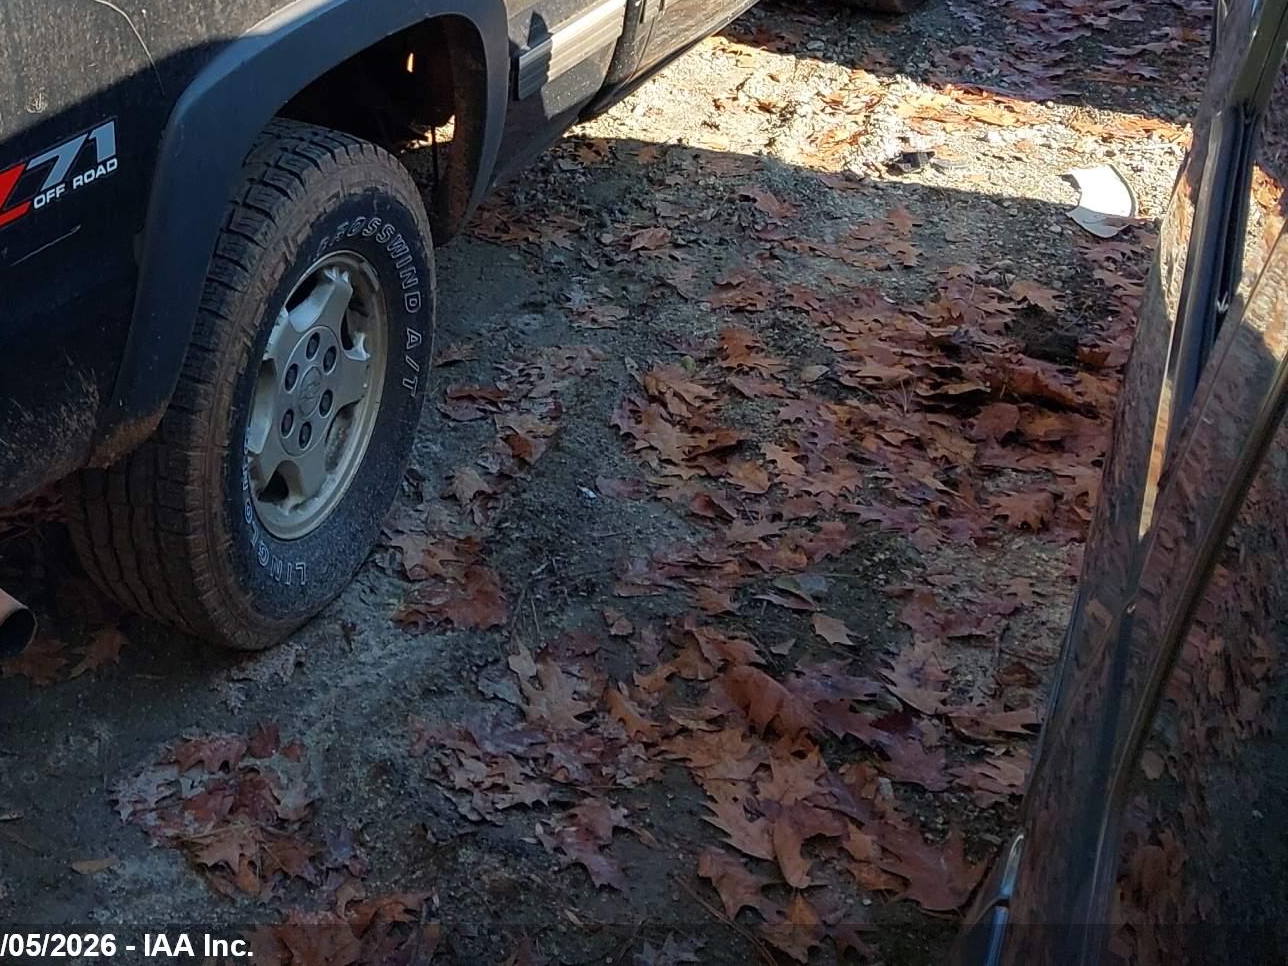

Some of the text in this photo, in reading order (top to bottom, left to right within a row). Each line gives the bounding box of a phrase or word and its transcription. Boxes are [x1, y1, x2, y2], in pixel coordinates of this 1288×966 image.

[33, 157, 118, 209] OFF ROAD
[401, 327, 423, 399] A/T
